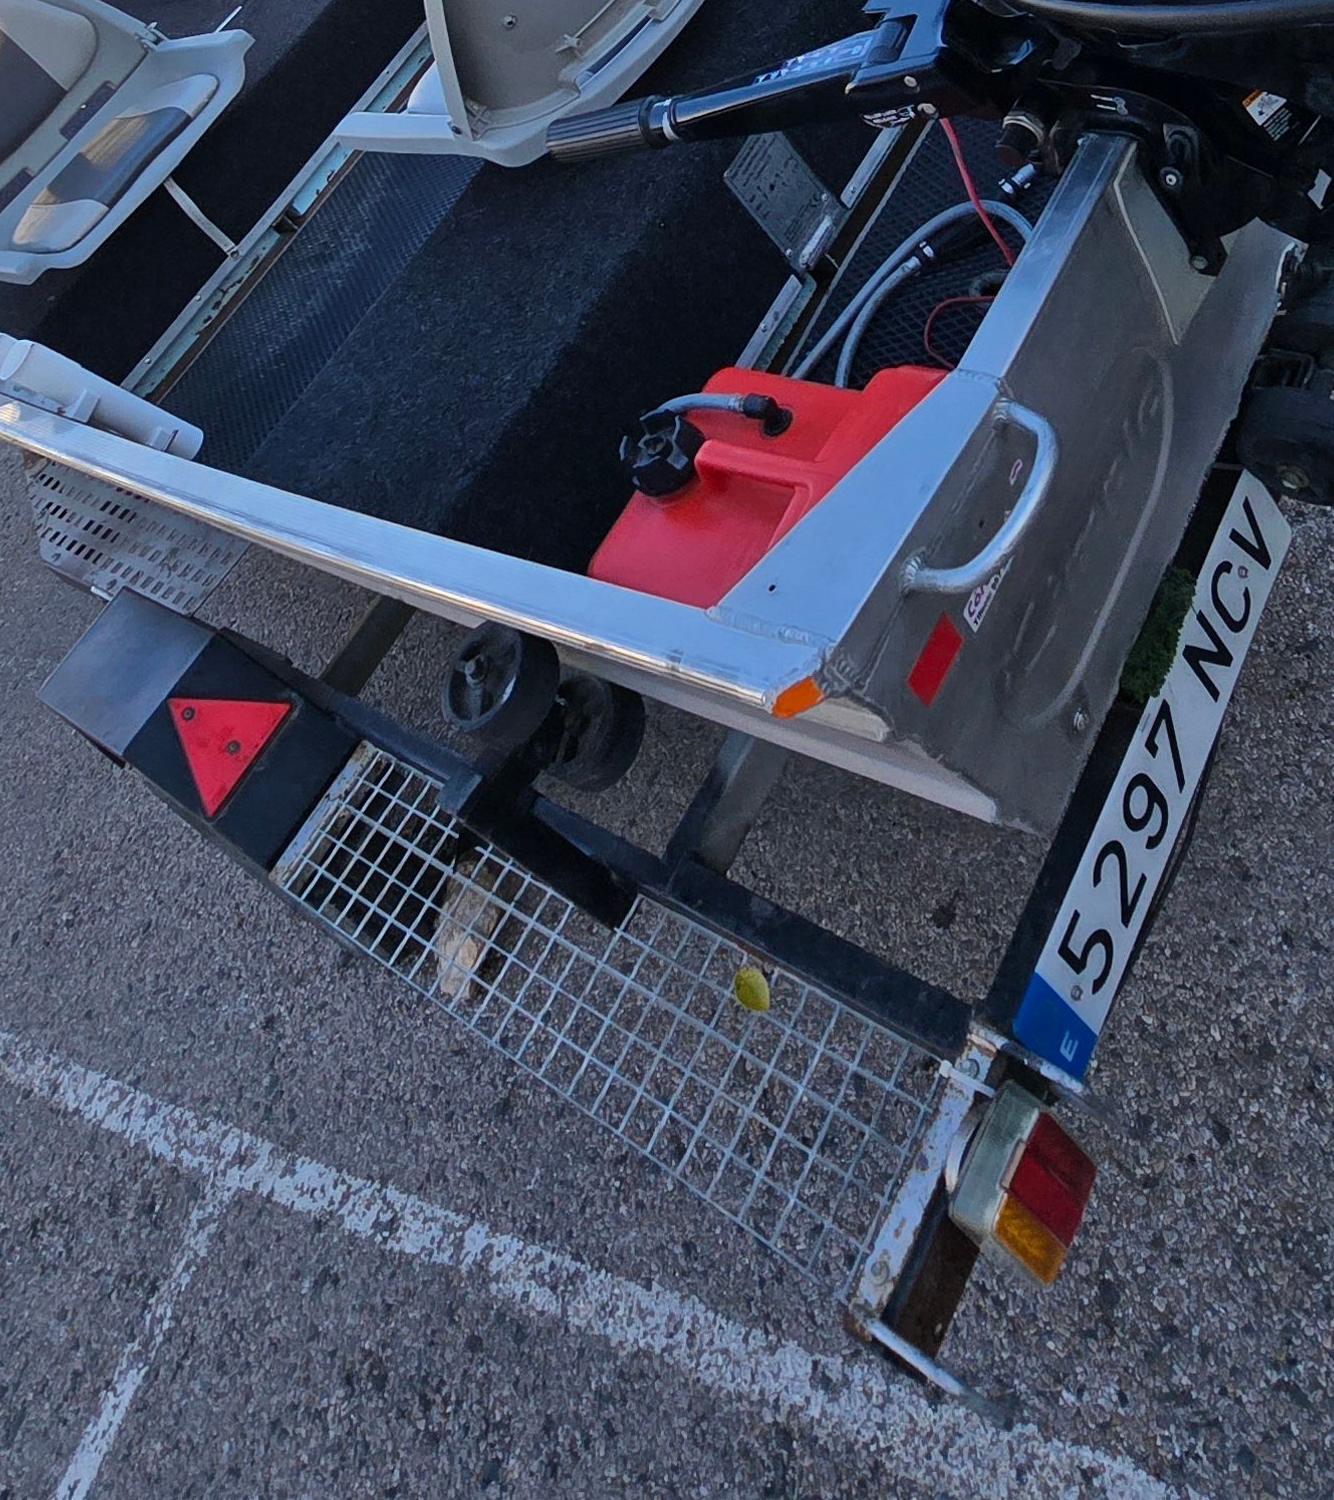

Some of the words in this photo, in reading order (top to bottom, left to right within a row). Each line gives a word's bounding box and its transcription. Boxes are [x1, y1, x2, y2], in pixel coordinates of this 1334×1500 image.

[1182, 496, 1272, 703] NCV
[1058, 699, 1186, 996] 5297
[1060, 1030, 1079, 1063] E
